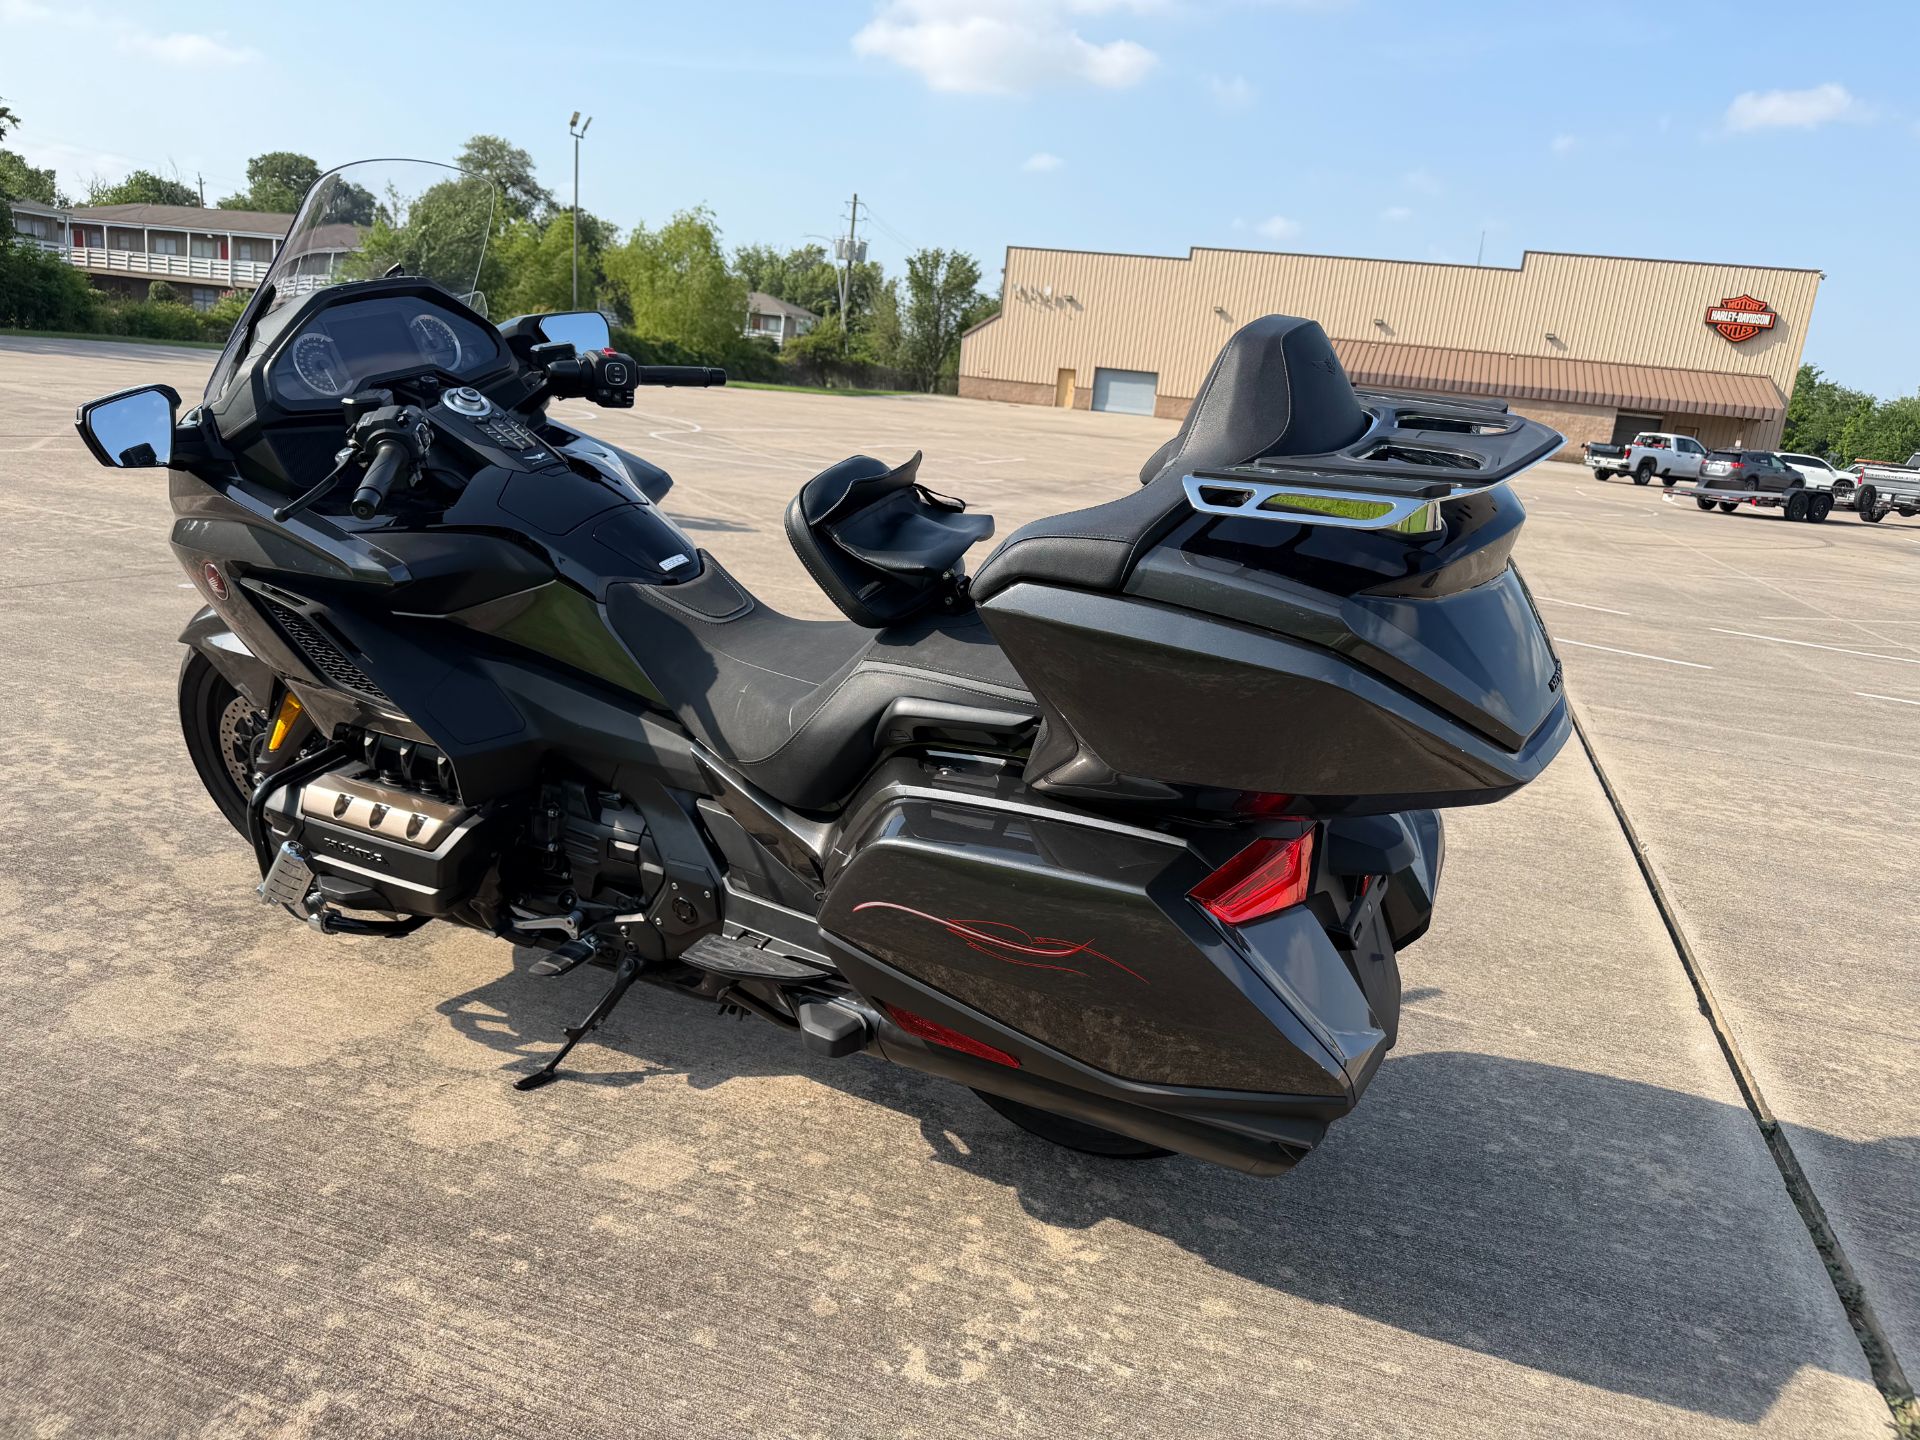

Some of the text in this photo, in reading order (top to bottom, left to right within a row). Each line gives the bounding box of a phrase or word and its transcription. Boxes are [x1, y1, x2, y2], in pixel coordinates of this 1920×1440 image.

[1727, 300, 1760, 311] MOTOR
[1710, 310, 1771, 325] HARLEY-DAVIDSON
[1721, 324, 1754, 338] CYCLES
